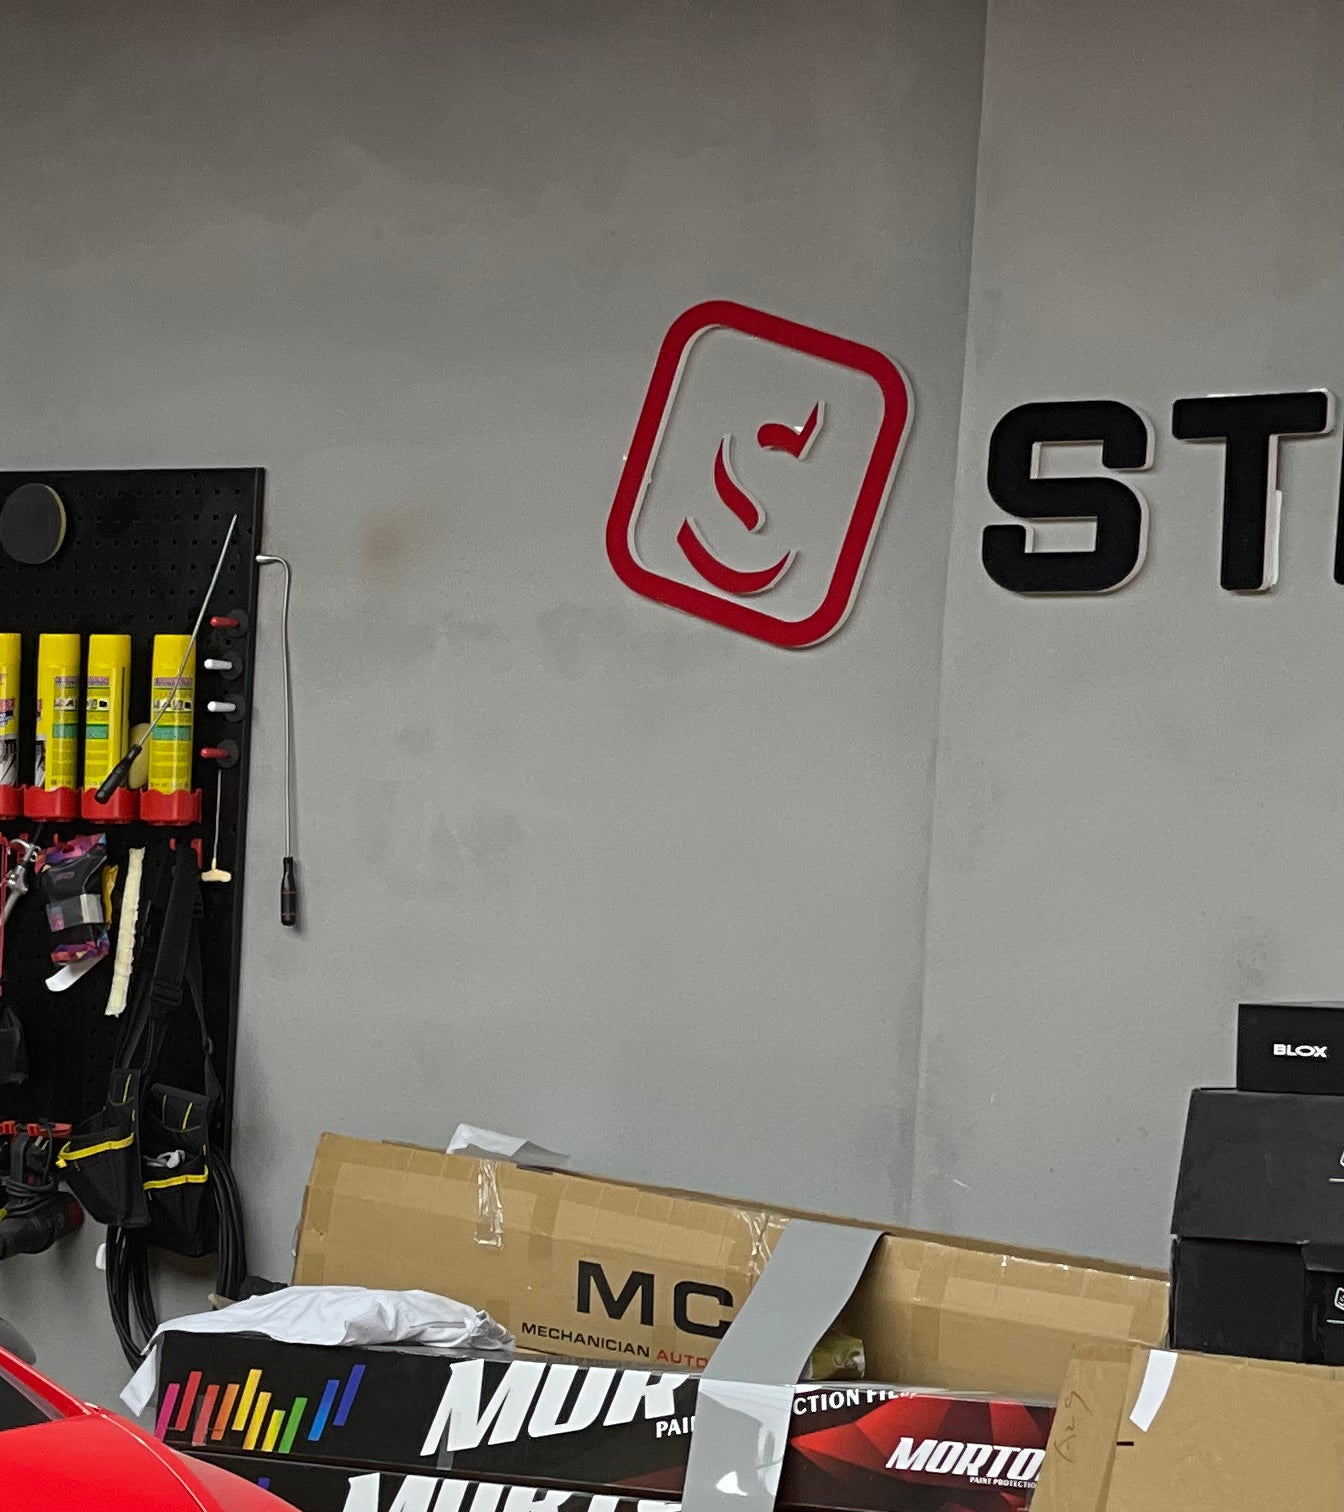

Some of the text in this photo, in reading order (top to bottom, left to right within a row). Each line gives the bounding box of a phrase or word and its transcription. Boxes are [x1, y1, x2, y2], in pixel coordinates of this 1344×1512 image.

[981, 390, 1344, 594] ST
[1272, 1042, 1328, 1059] BLOX
[521, 1322, 651, 1358] MECHANICIAN
[655, 1415, 696, 1439] PAI
[792, 1388, 860, 1416] CTION
[885, 1436, 1047, 1482] MORTO
[993, 1477, 1037, 1489] PROTECTIO
